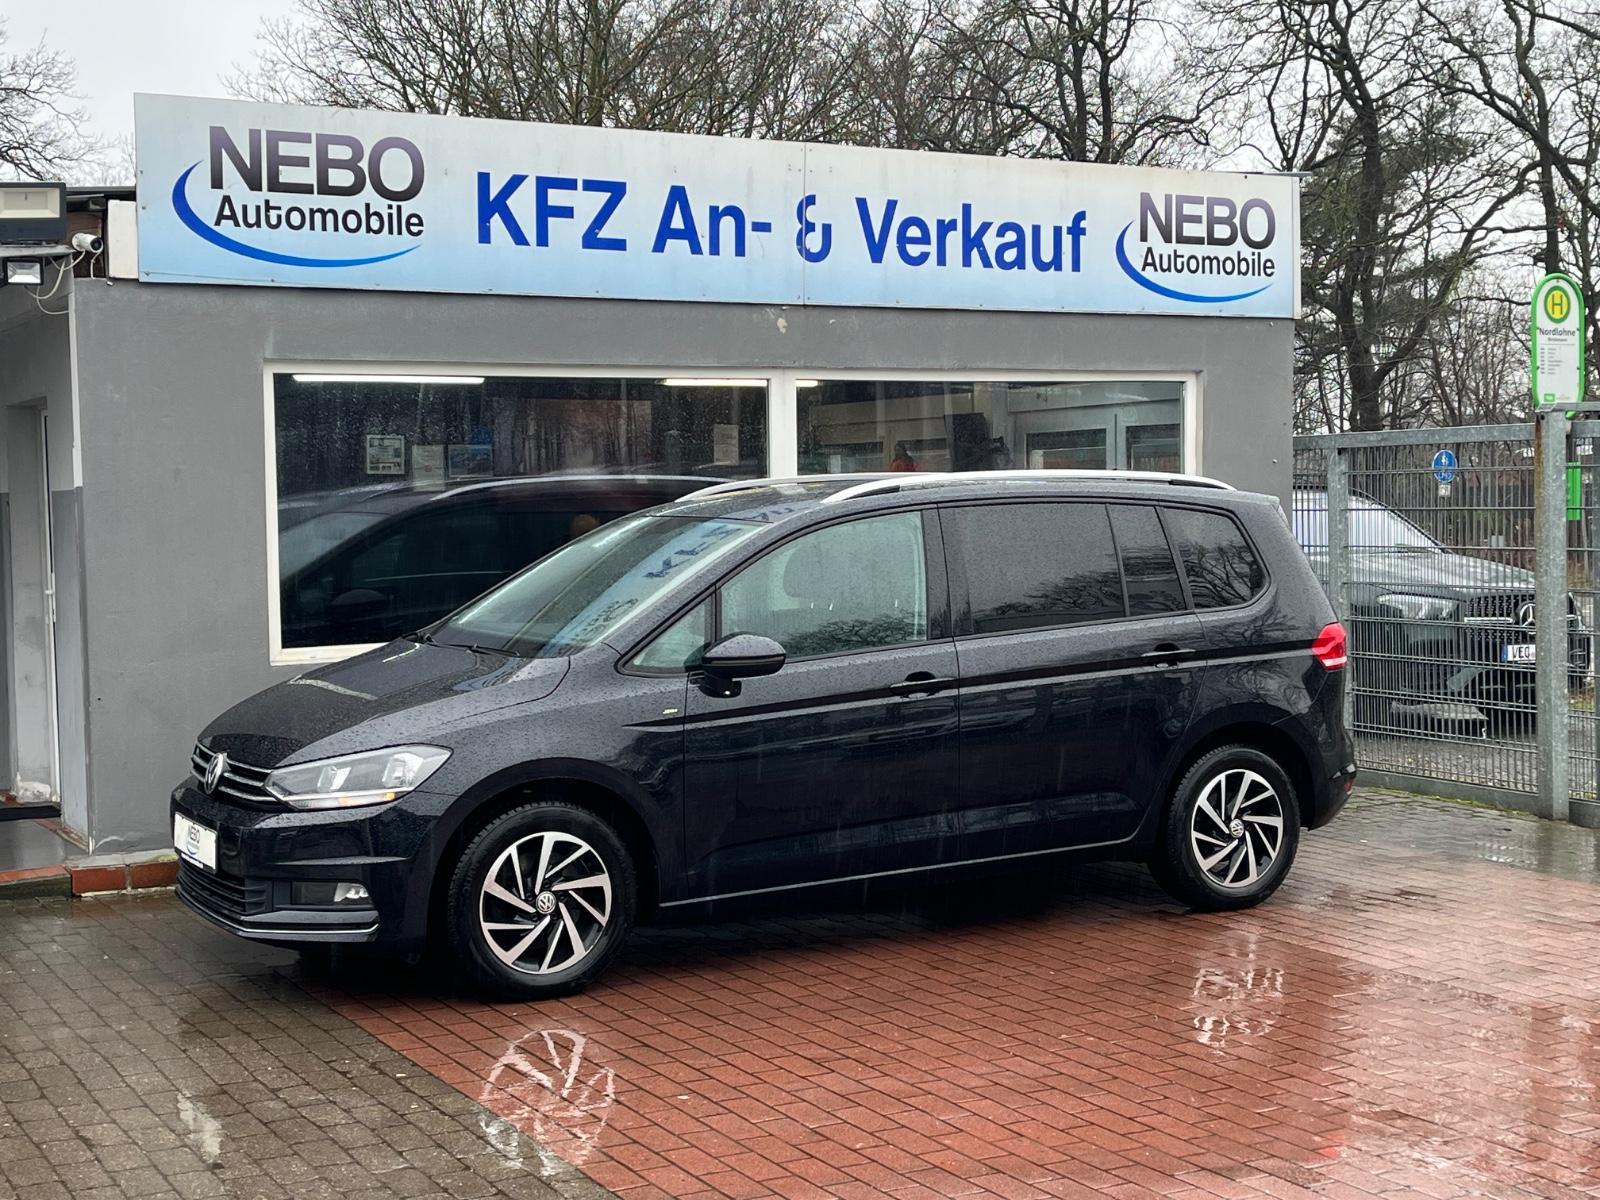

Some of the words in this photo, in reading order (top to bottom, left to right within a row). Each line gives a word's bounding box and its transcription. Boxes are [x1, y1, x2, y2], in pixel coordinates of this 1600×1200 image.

[209, 126, 425, 203] NEBO
[213, 194, 424, 238] Automobile
[477, 171, 627, 252] KFZ
[652, 185, 772, 257] An-
[796, 194, 832, 263] &
[856, 197, 1087, 273] Verkauf
[1139, 192, 1276, 250] NEBO
[1141, 246, 1276, 278] Automobile
[1551, 293, 1563, 316] H
[1539, 327, 1576, 337] Nordlohne
